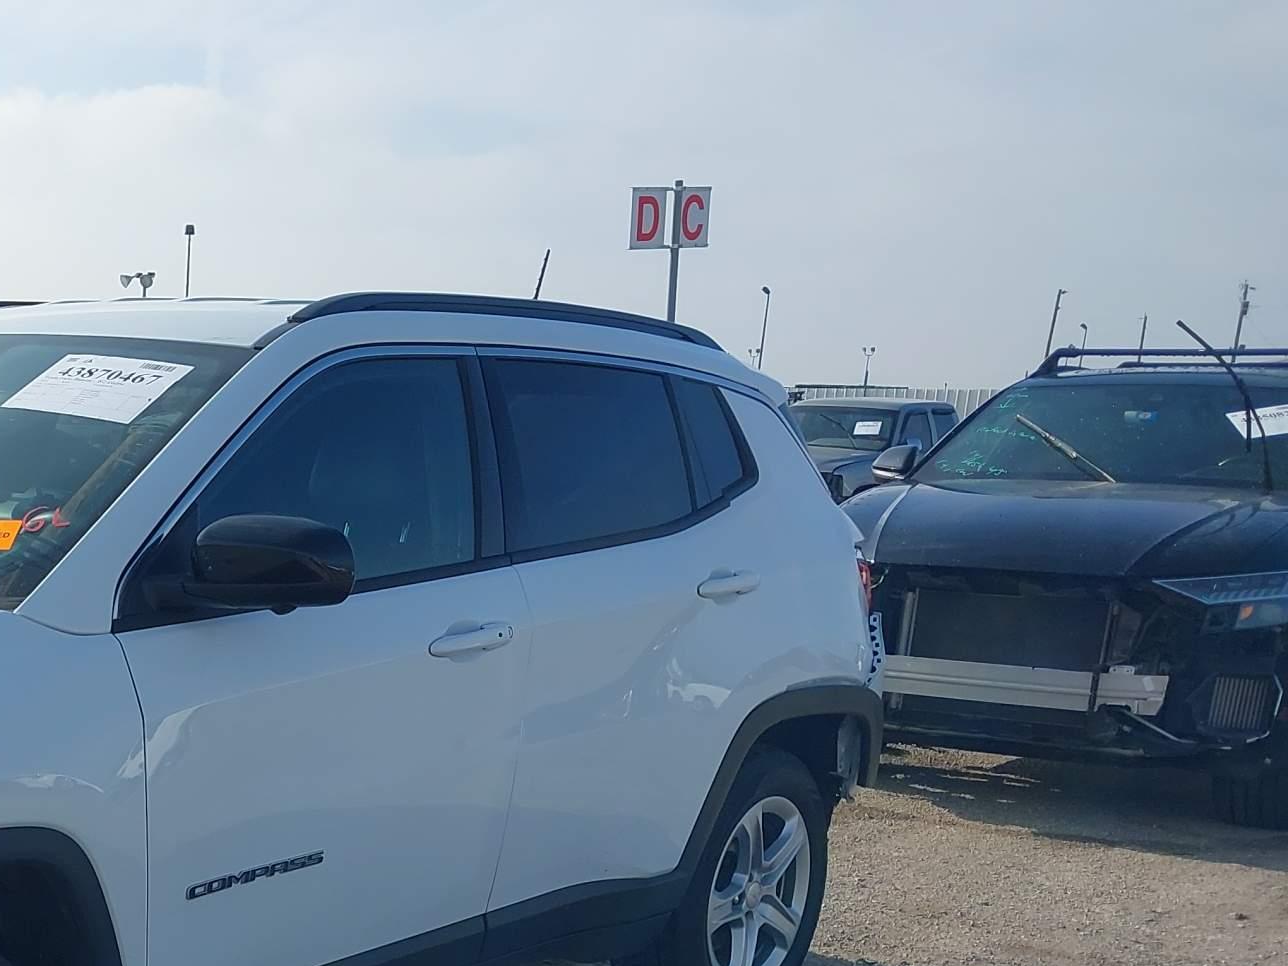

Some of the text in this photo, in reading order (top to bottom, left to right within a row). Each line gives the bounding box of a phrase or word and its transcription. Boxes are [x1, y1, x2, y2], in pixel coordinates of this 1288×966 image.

[636, 195, 660, 242] D
[682, 193, 705, 241] C
[58, 366, 165, 386] 43870467
[186, 849, 325, 901] COMPASS
